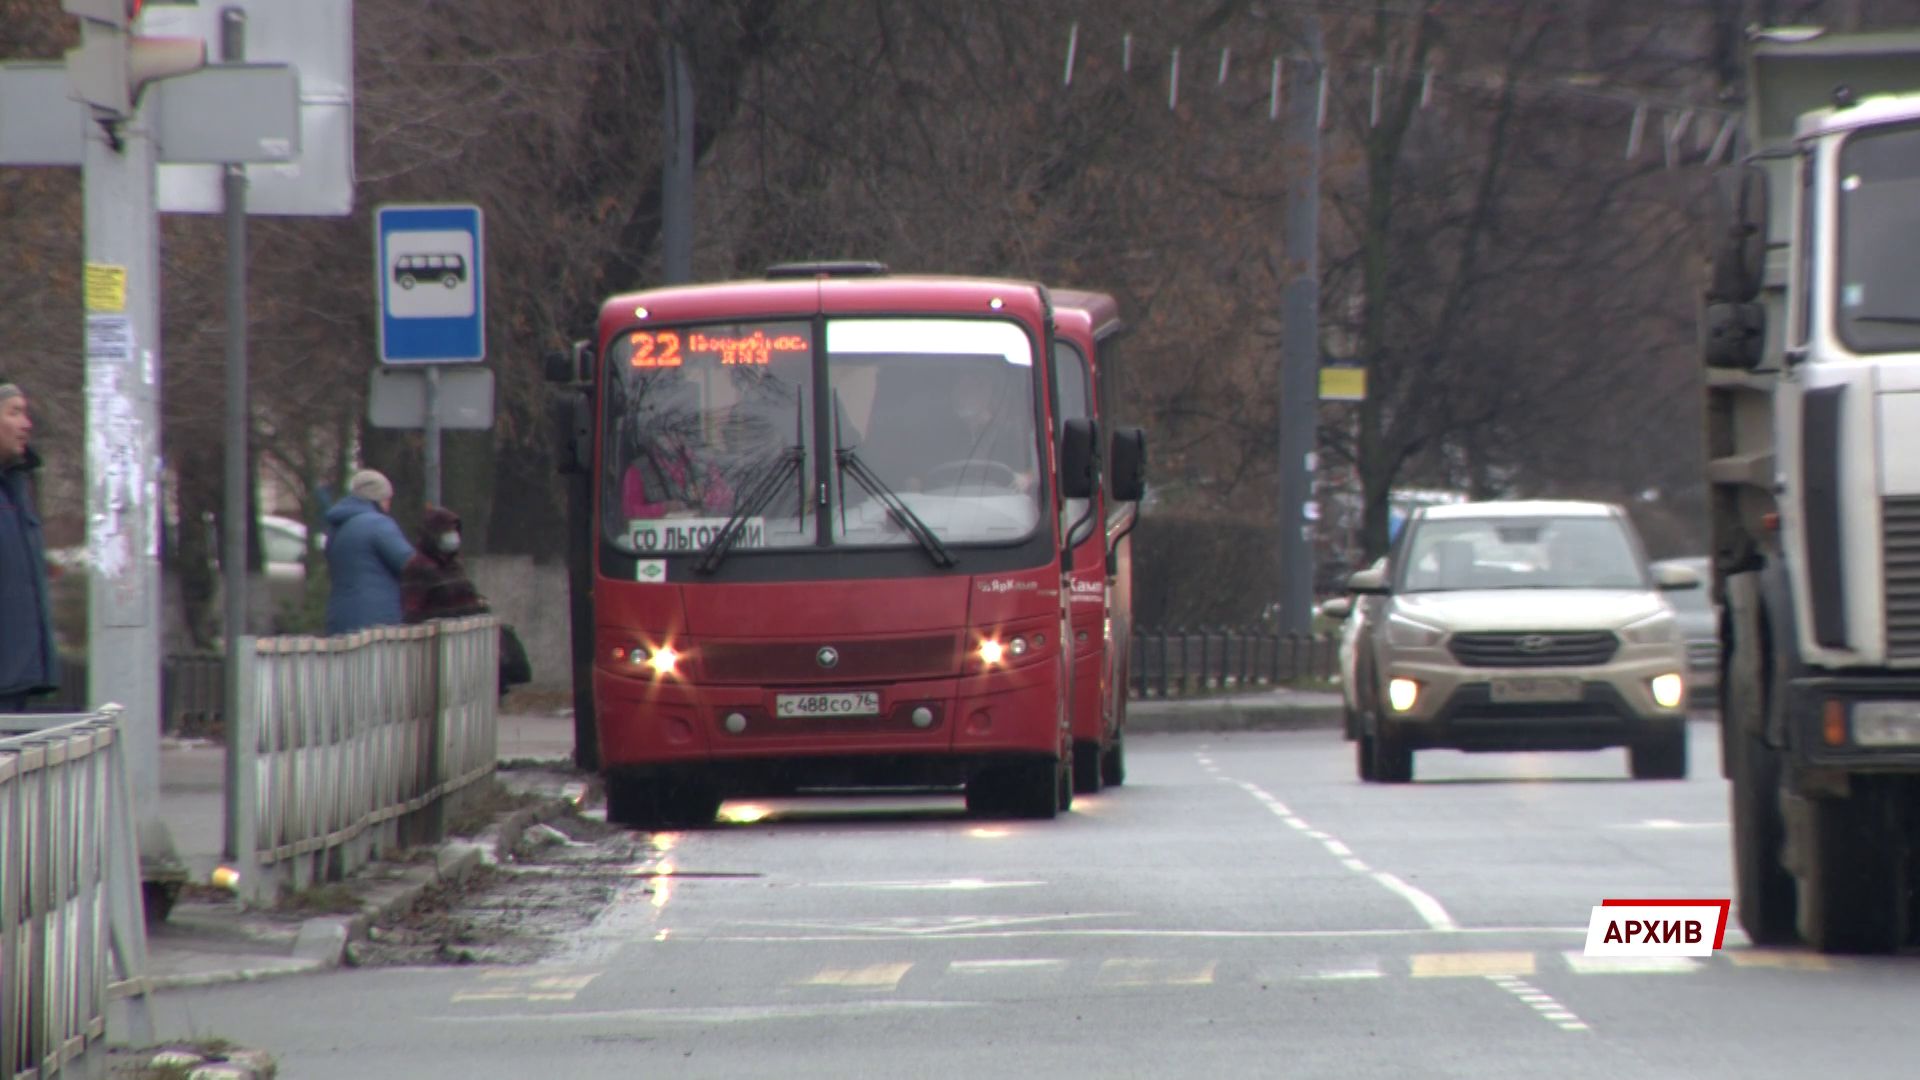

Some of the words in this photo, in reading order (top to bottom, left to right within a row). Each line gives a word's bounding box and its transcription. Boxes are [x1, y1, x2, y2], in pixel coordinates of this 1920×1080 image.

[631, 332, 682, 366] 22
[633, 528, 657, 550] СО
[664, 525, 762, 550] ЛЬГОТМИ
